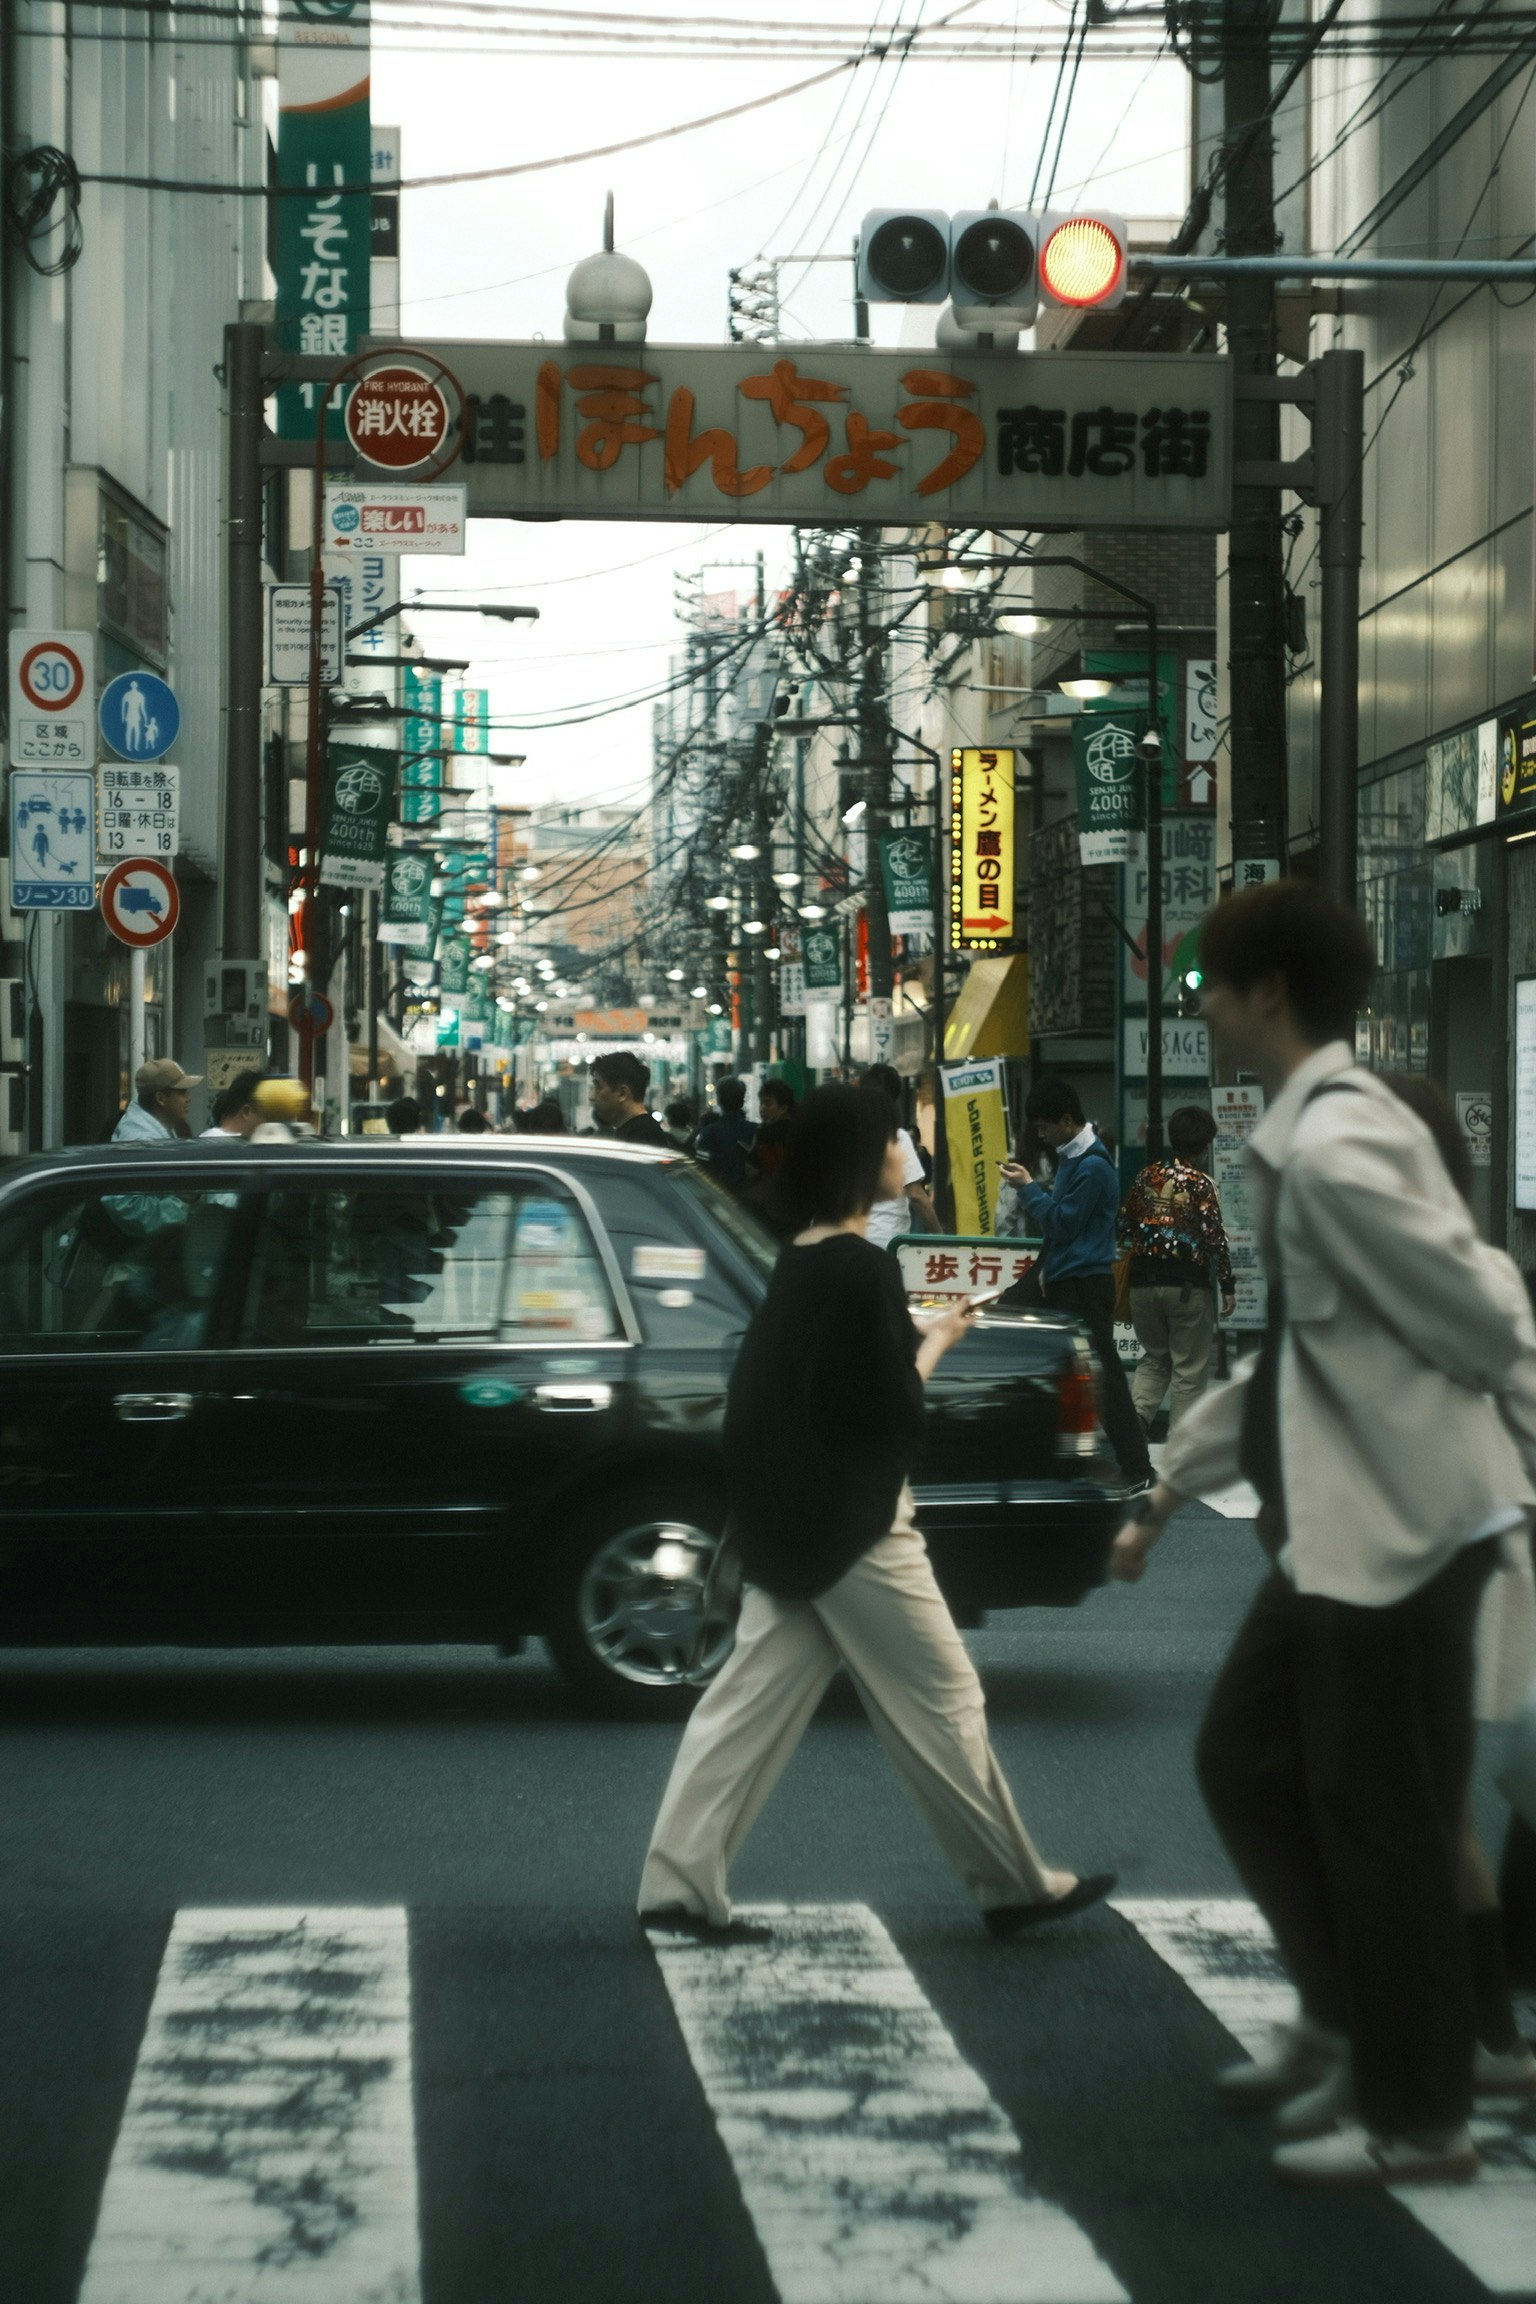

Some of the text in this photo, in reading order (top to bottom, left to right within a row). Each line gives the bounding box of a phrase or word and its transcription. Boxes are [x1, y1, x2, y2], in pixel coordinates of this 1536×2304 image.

[364, 381, 430, 392] FIRE HYDRANT
[356, 398, 440, 437] 消火栓
[353, 537, 374, 548] ここ
[34, 661, 70, 692] 30
[36, 725, 69, 739] 区域
[23, 741, 82, 757] ここから
[103, 771, 176, 789] 自転車を除く
[108, 791, 123, 808] 16
[157, 792, 172, 809] 18
[329, 823, 375, 842] 400th
[976, 752, 1002, 910] ラーメン鷹の目
[108, 832, 124, 849] 13
[157, 833, 171, 850] 18
[16, 887, 90, 905] ゾーン30
[894, 886, 929, 898] 400th
[1139, 1031, 1206, 1055] VSAGE
